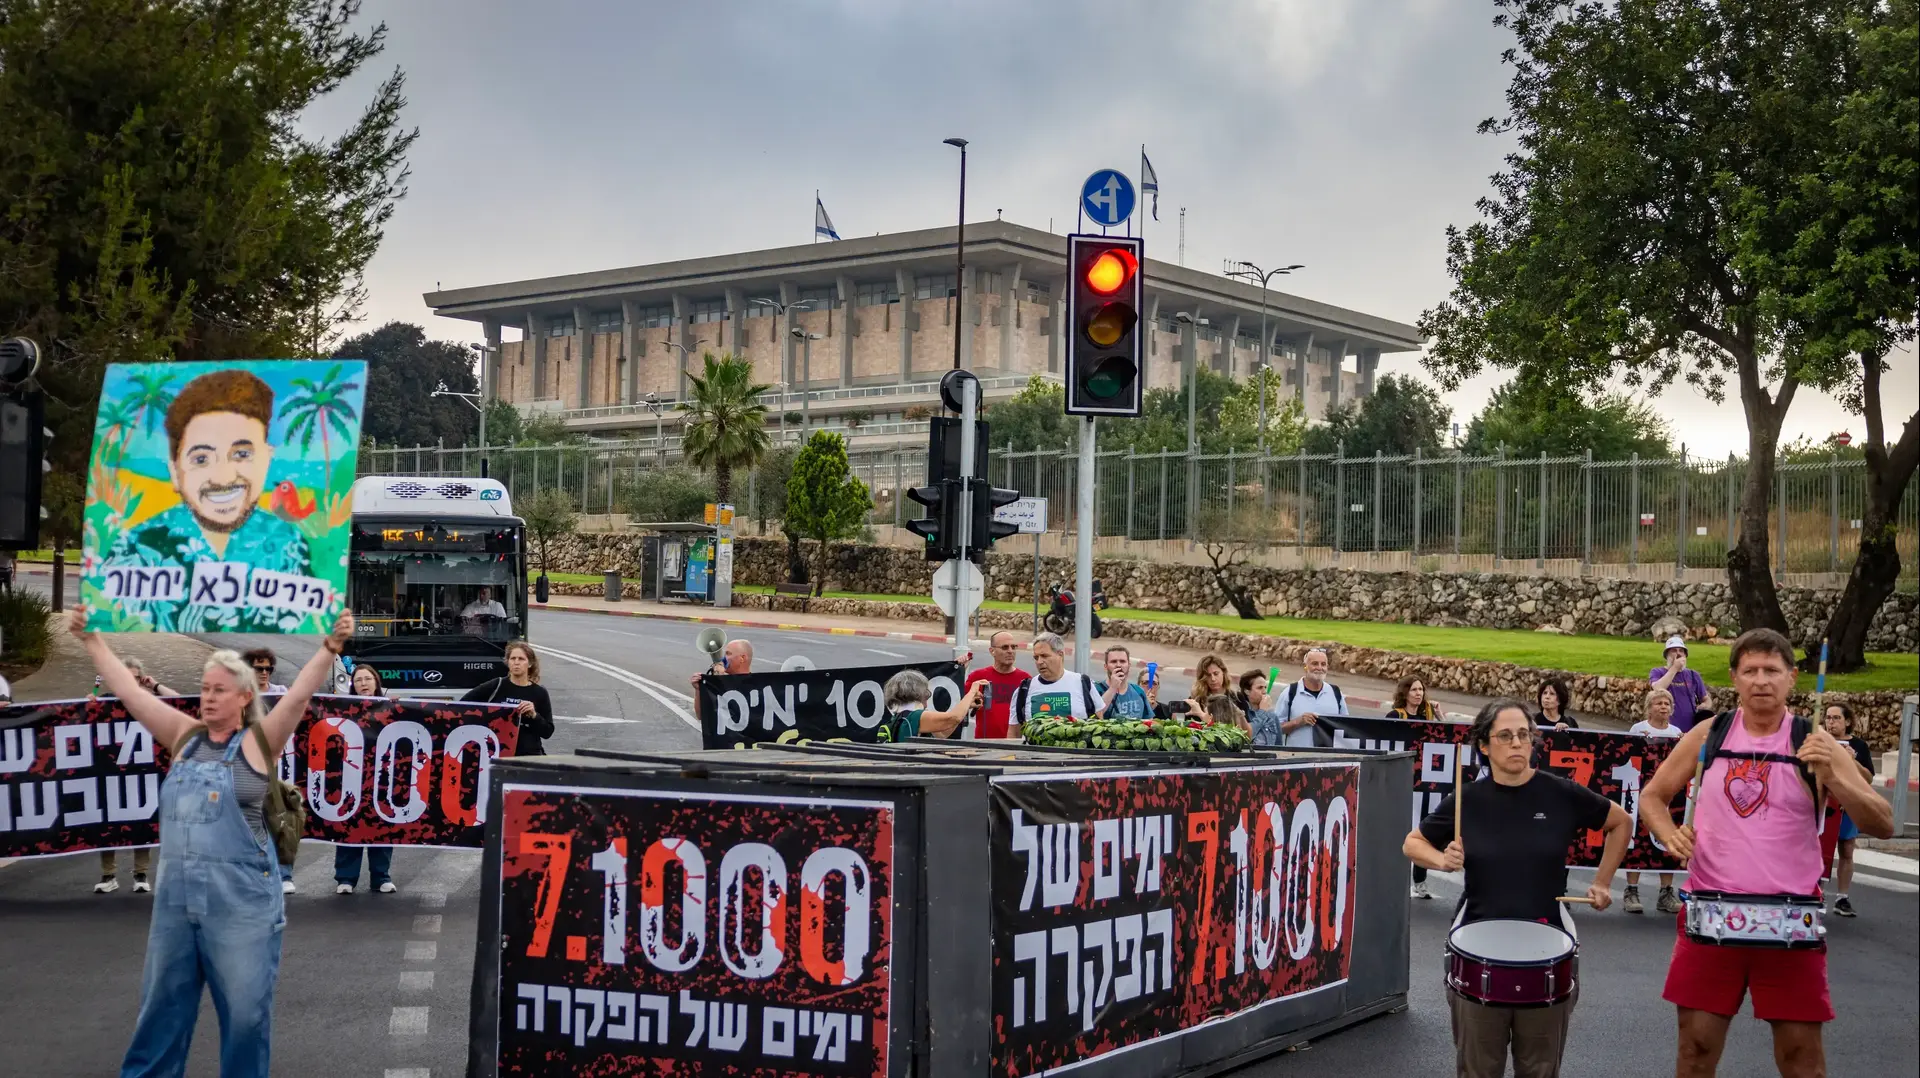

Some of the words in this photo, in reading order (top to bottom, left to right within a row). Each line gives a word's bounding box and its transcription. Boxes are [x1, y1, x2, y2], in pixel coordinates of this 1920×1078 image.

[481, 490, 501, 500] CNG
[107, 569, 181, 598] יחזור
[193, 565, 239, 604] לא
[254, 577, 325, 610] הירש
[463, 662, 494, 671] HIGER
[716, 683, 808, 736] ימים
[826, 675, 962, 729] 100
[54, 720, 154, 770] מים
[1011, 808, 1079, 912] של
[1093, 814, 1173, 900] ימים
[519, 832, 871, 987] 7.1000
[1187, 796, 1350, 986] 7.1000
[1013, 908, 1173, 1032] הפקרה
[516, 983, 669, 1047] הפקרה
[679, 988, 748, 1052] של
[762, 1007, 863, 1063] ימים
